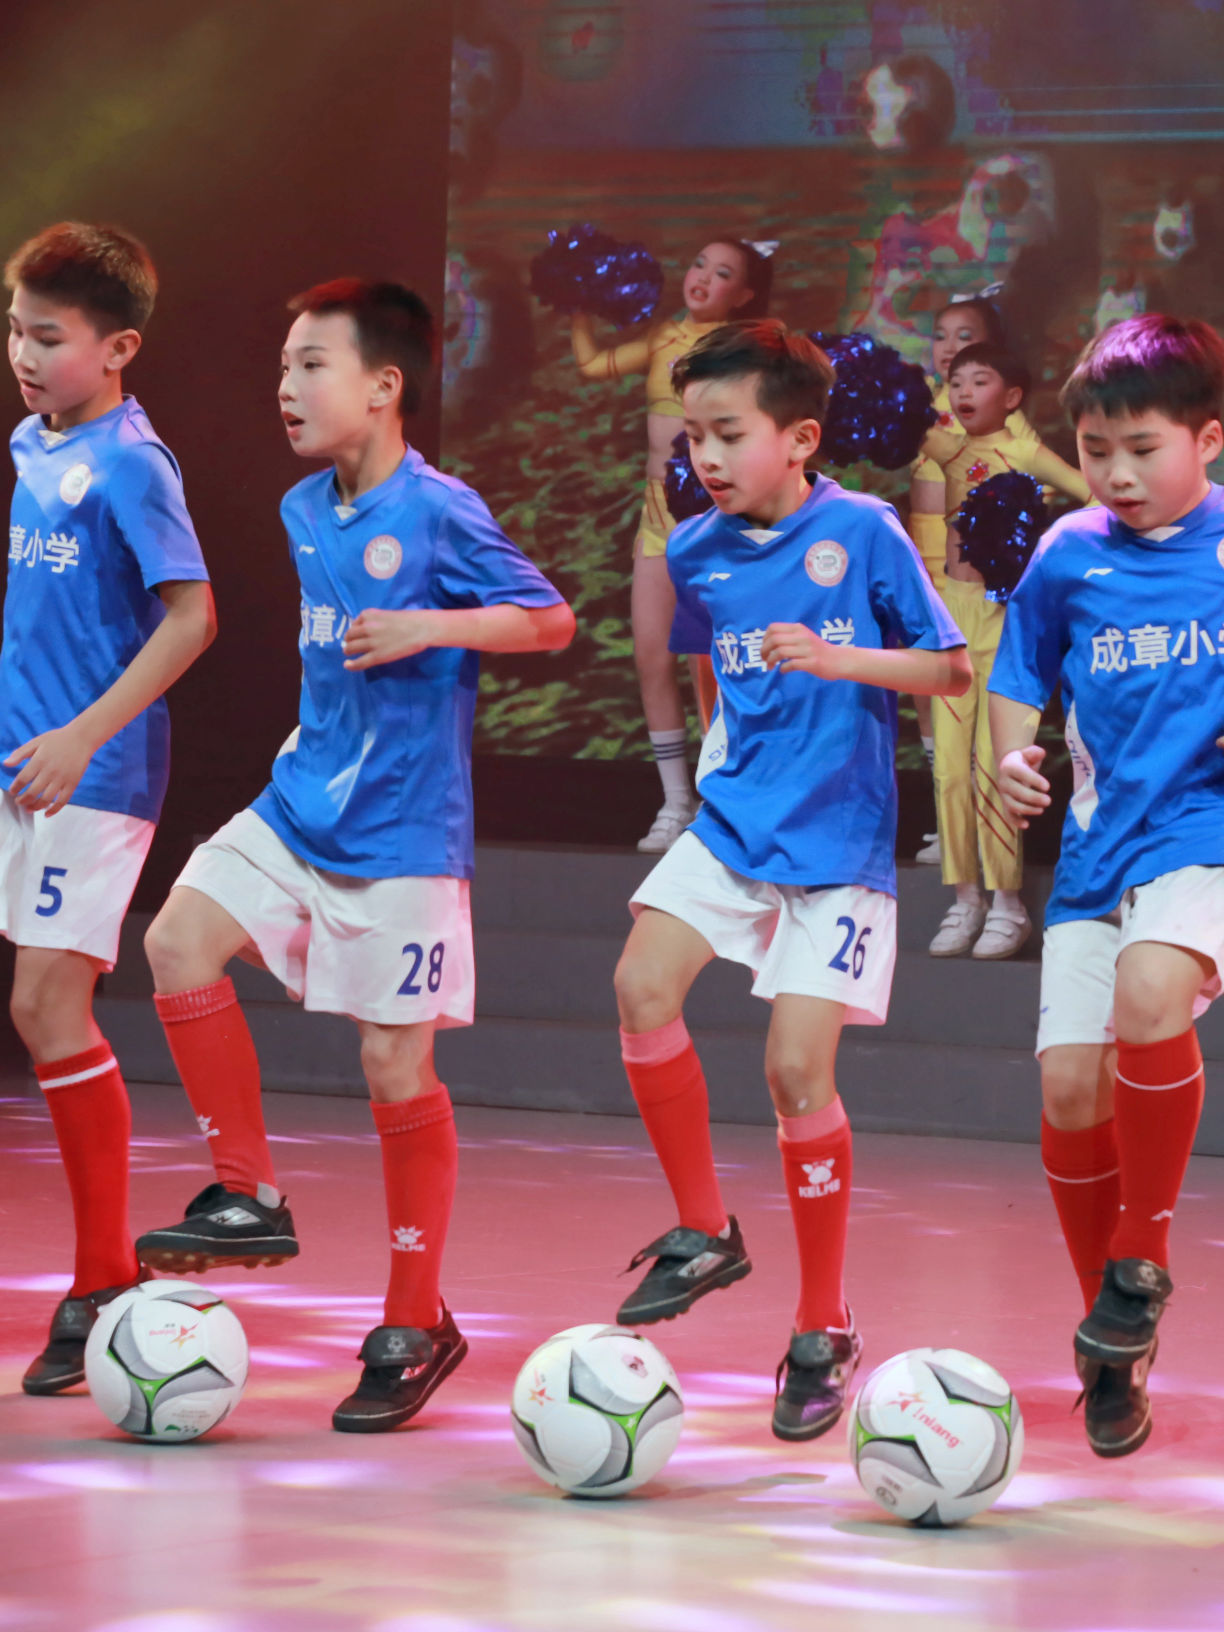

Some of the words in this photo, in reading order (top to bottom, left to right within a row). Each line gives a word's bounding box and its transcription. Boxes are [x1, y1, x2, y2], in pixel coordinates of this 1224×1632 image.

[715, 617, 856, 675] 成章学
[35, 865, 68, 917] 5
[396, 941, 445, 996] 28
[827, 915, 872, 981] 26
